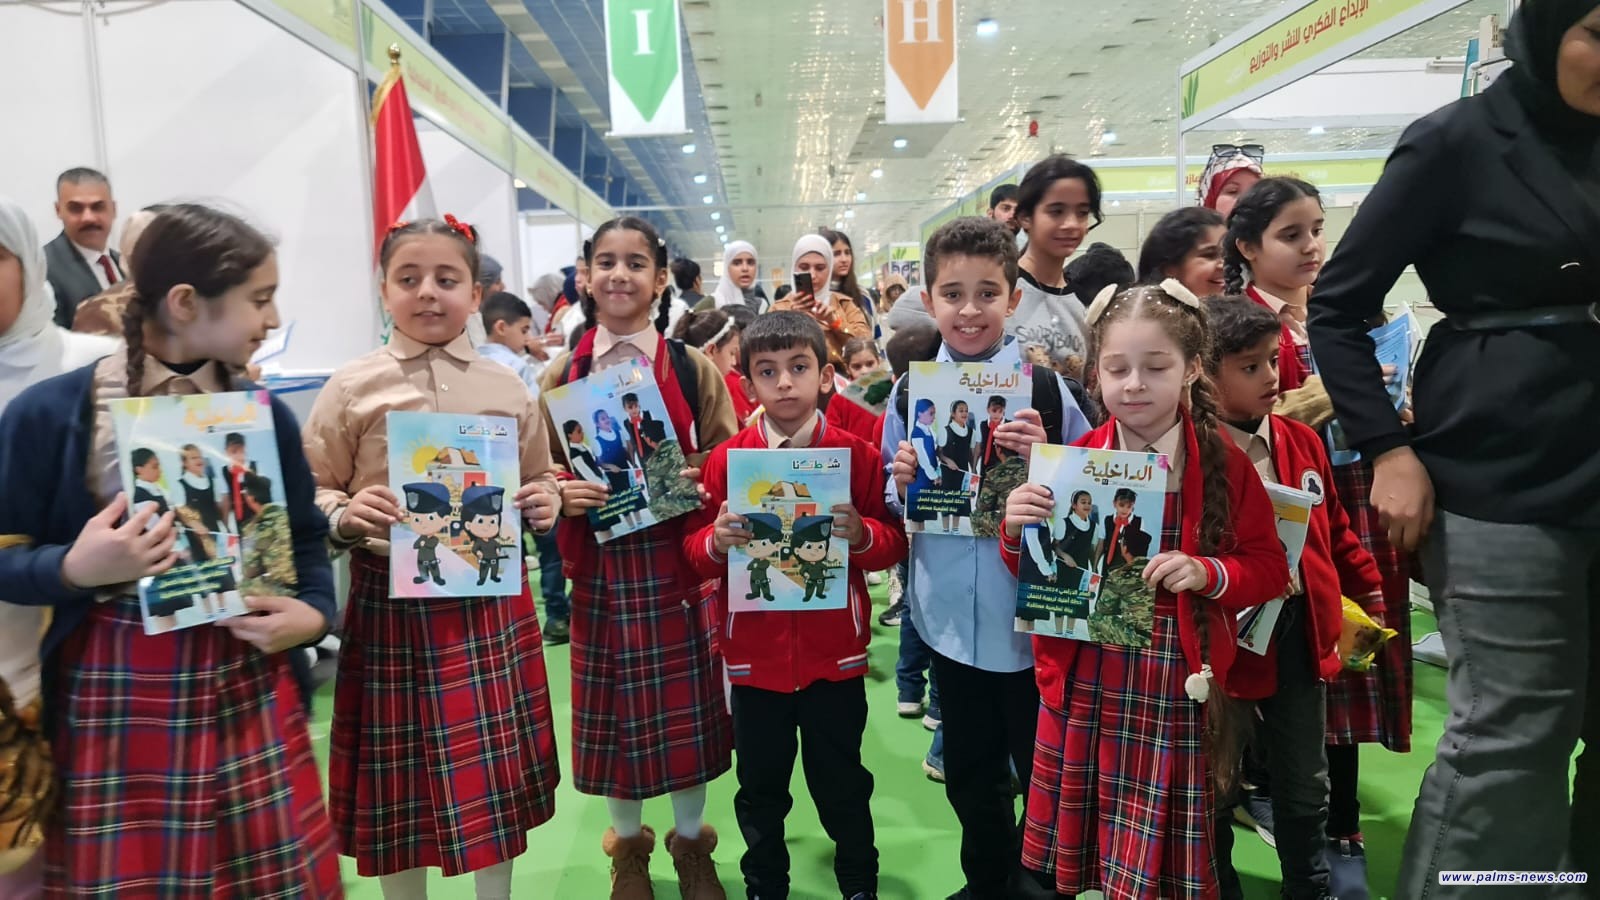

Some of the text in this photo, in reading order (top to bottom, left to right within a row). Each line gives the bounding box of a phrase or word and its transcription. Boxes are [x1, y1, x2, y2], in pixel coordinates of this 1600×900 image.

[631, 9, 655, 55] I
[898, 0, 944, 43] H
[1303, 7, 1337, 43] الفكري
[1249, 42, 1279, 74] والتوزيع
[1280, 27, 1300, 57] للنشر
[959, 372, 1019, 391] الداخلية
[1083, 460, 1152, 482] الداخلية
